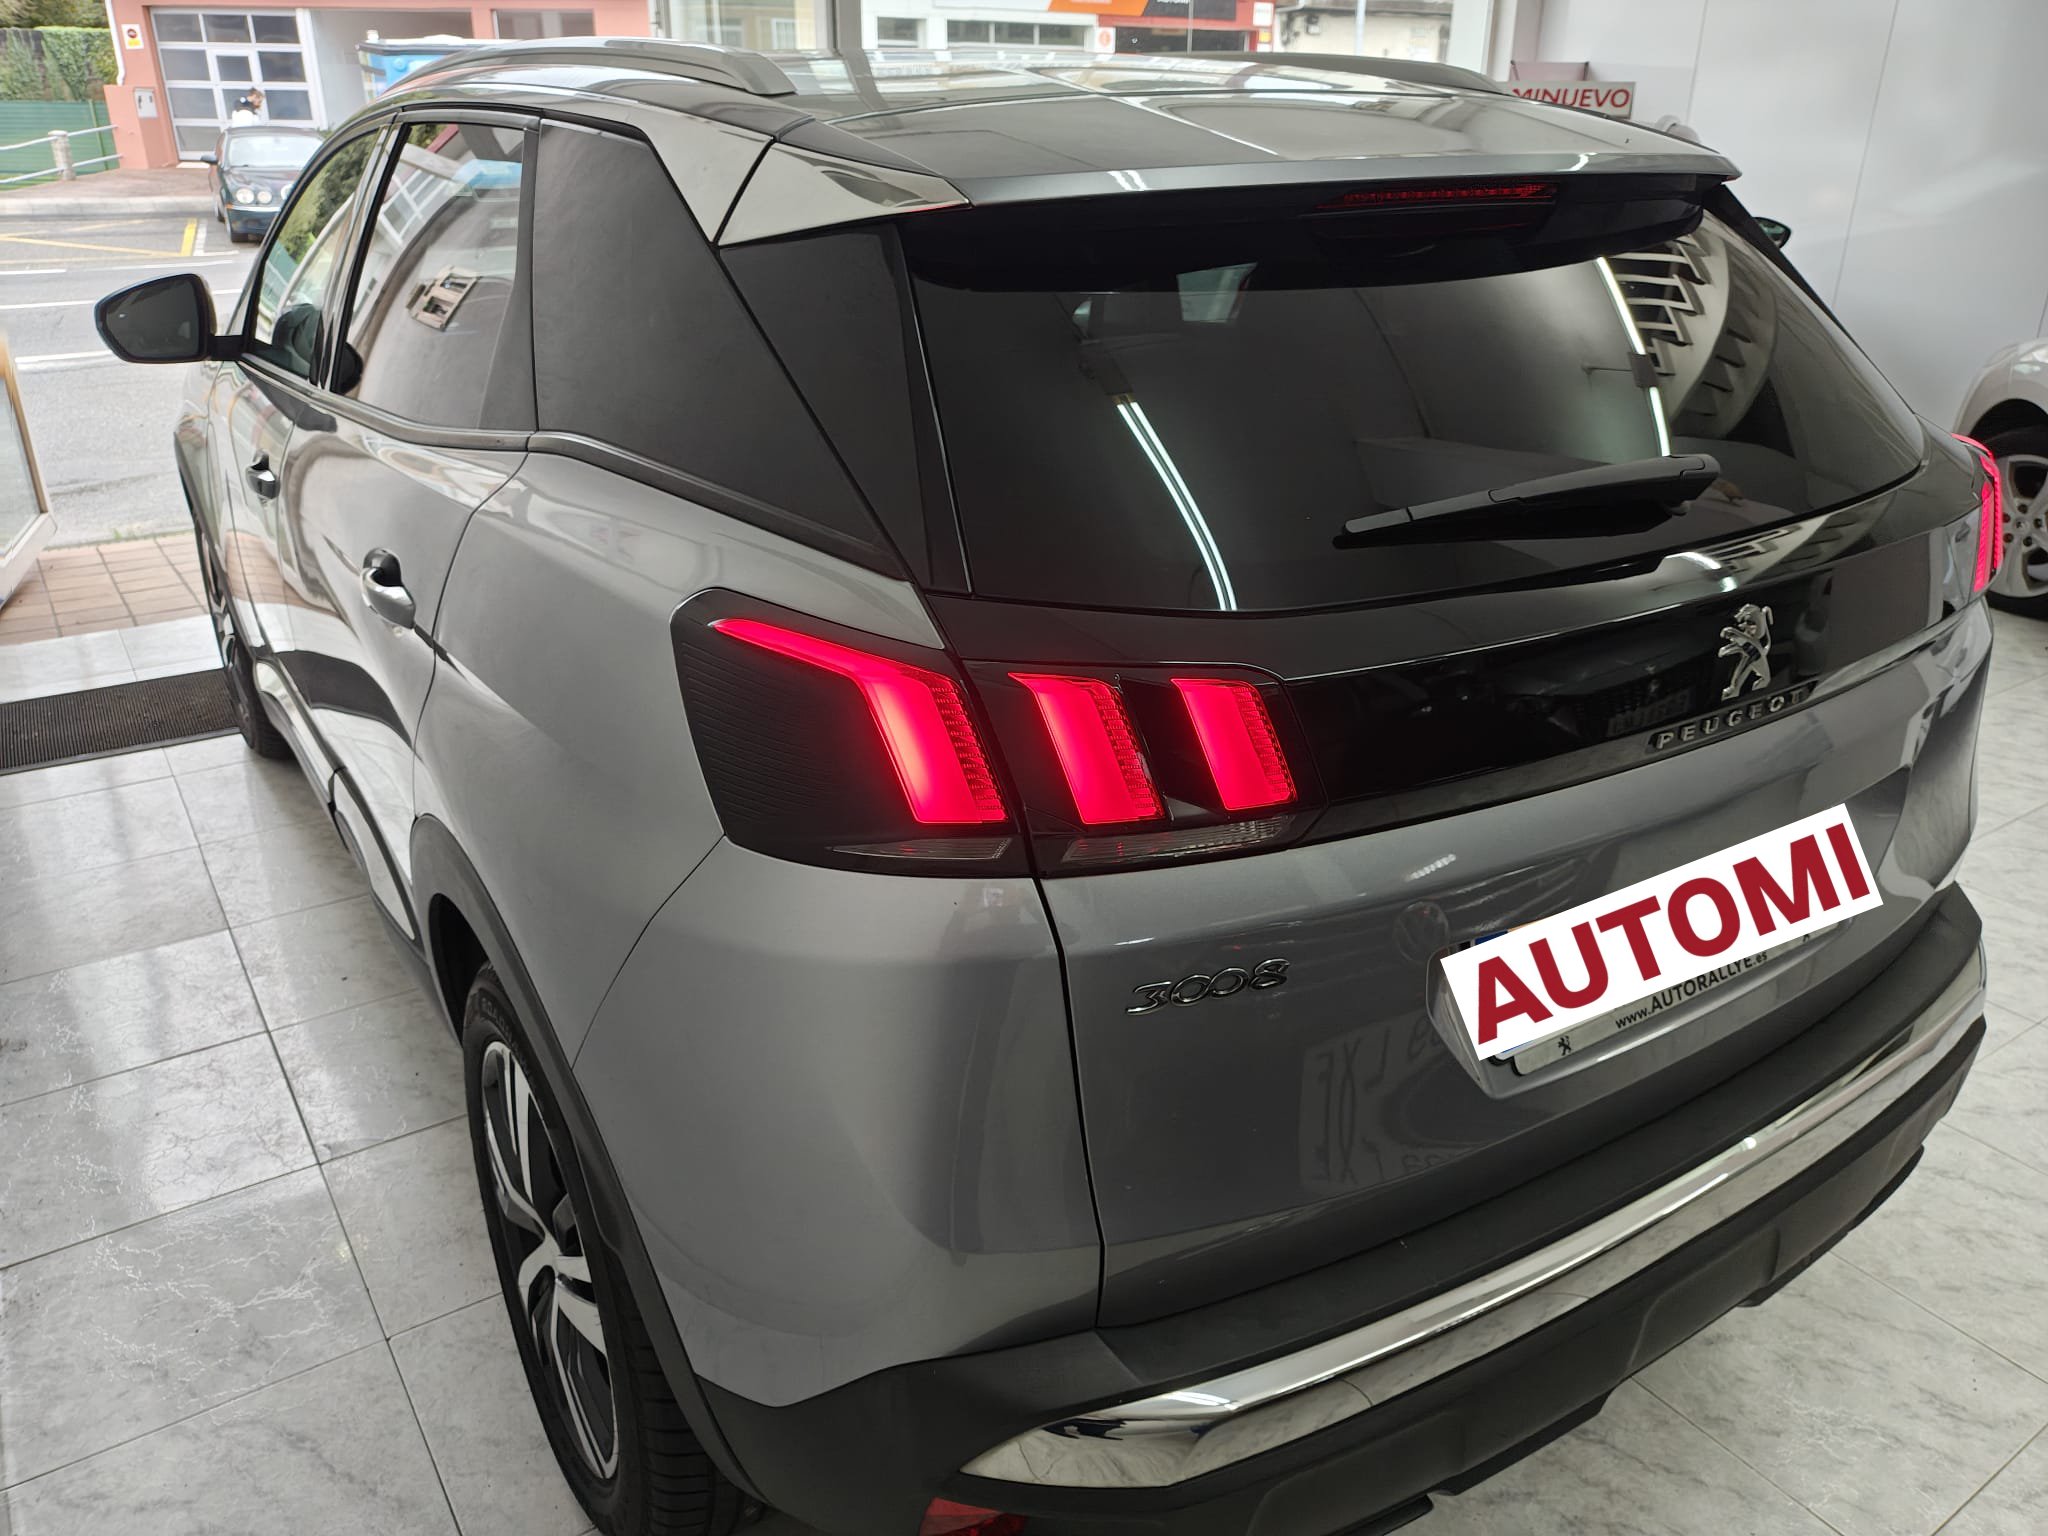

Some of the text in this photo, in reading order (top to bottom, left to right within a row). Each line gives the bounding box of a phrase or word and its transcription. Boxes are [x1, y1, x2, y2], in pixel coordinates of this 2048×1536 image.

[1656, 688, 1804, 749] PEUGEOT
[1126, 958, 1290, 1015] 3008
[1615, 951, 1768, 1029] www.AUTORALLYE.es
